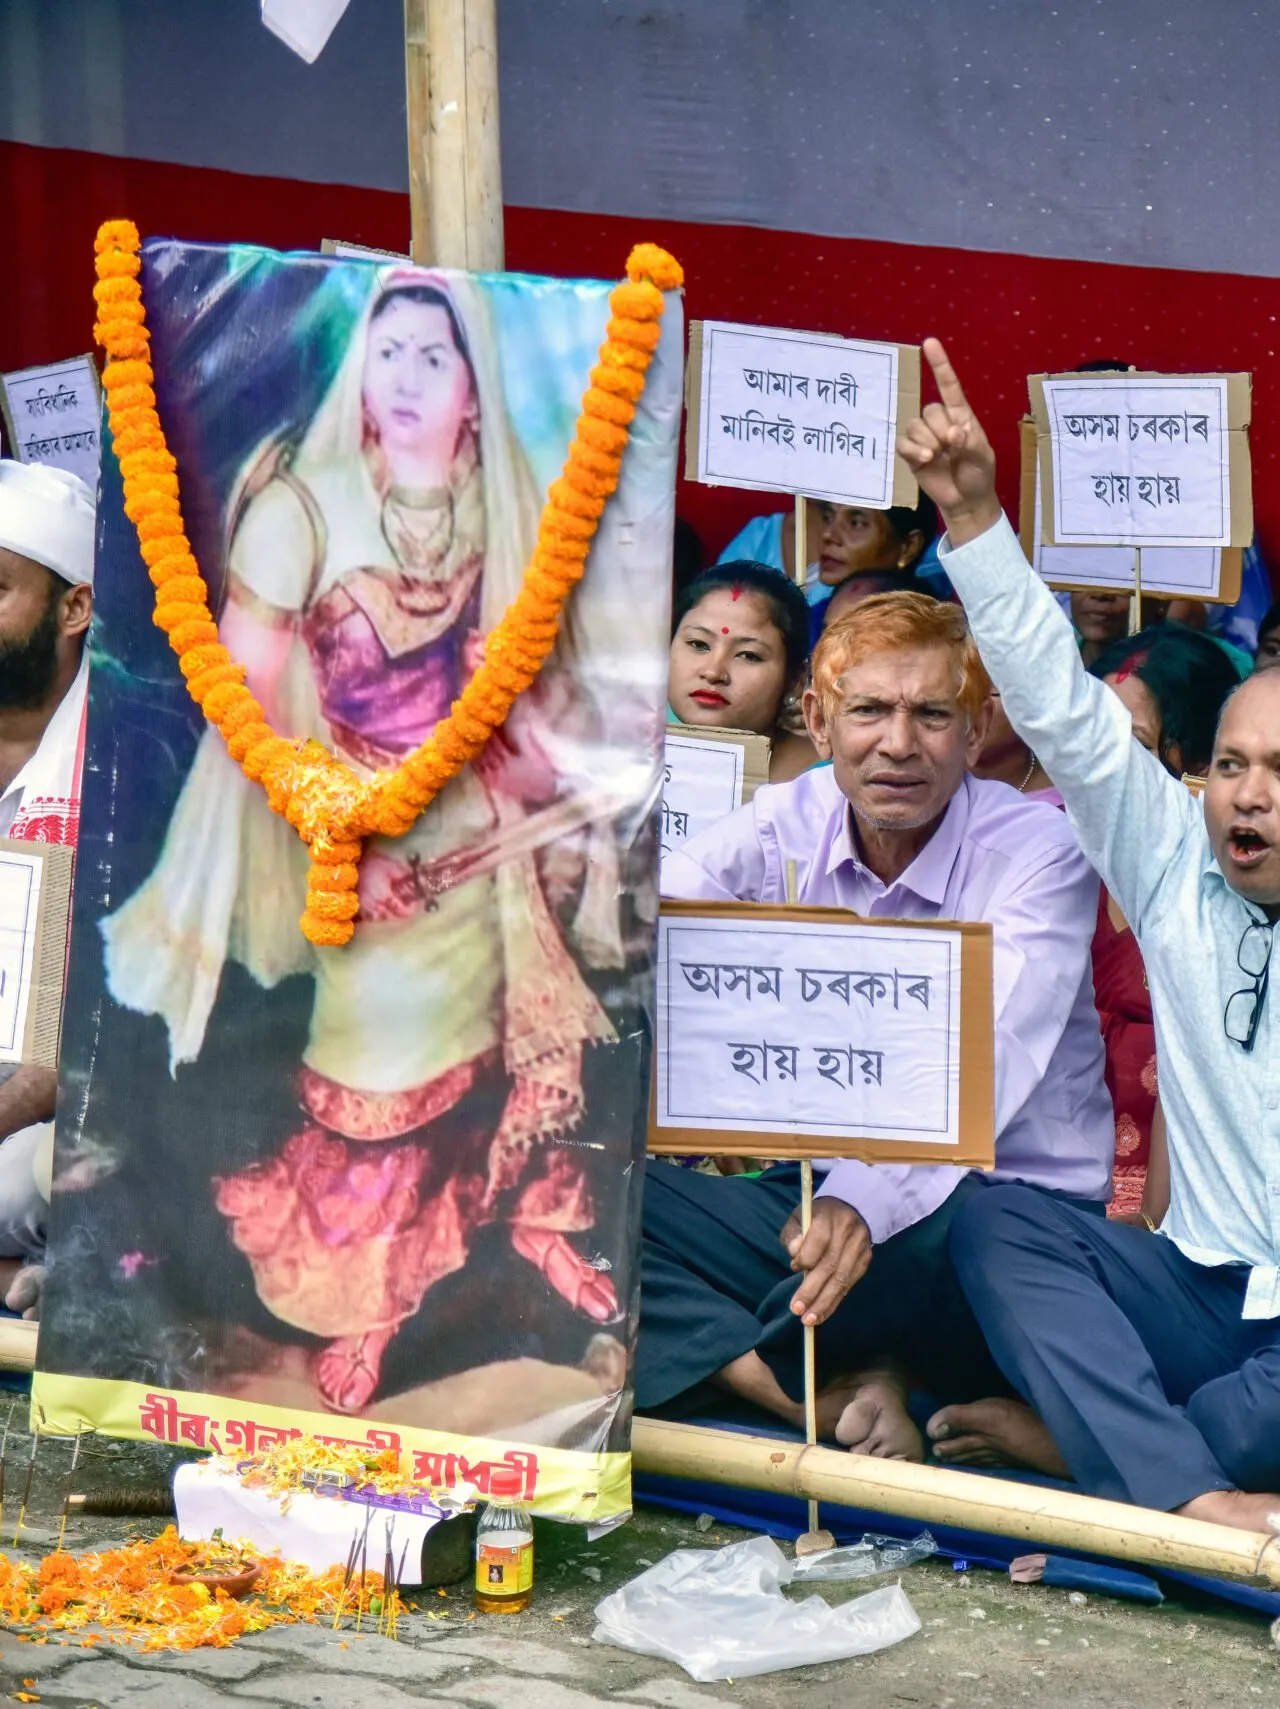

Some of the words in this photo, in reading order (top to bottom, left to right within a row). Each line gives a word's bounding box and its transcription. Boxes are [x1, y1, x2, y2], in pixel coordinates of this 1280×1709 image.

[742, 368, 809, 399] আমাৰ
[815, 372, 859, 408] দাবী
[720, 409, 796, 451] মানিবই
[1062, 414, 1121, 443] অসম
[1126, 410, 1210, 443] চৰকাৰ
[1091, 471, 1130, 507] হায়
[1134, 472, 1181, 508] হায়
[679, 962, 784, 1002] অসম
[794, 967, 933, 1010] চৰকাৰ
[727, 1039, 800, 1085] হায়
[812, 1043, 885, 1090] হায়
